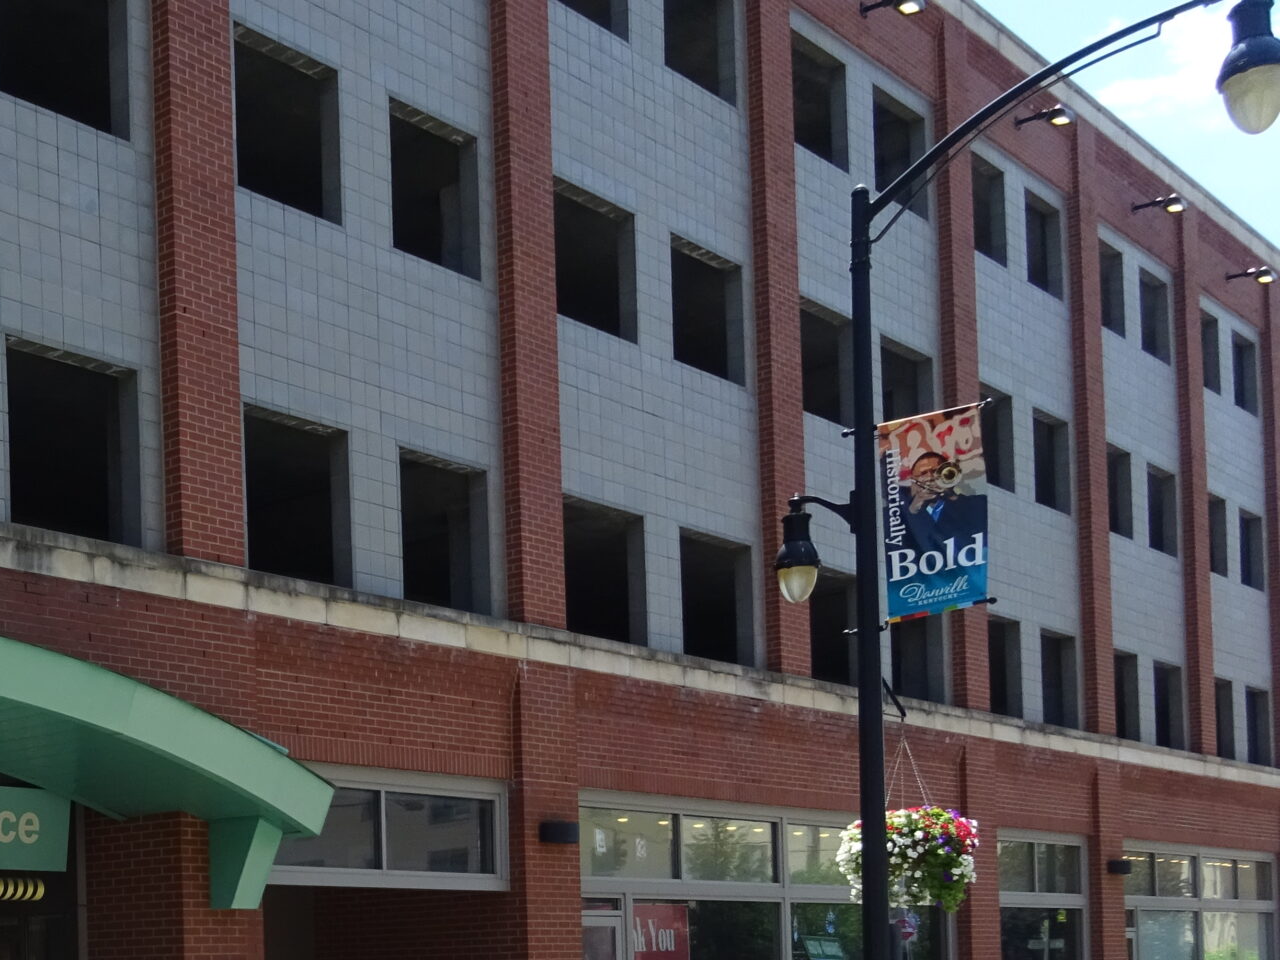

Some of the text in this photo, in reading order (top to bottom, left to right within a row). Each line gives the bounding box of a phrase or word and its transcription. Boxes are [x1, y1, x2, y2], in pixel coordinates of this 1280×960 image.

[885, 449, 907, 546] Historically
[888, 532, 987, 582] Bold
[899, 575, 970, 602] Danville
[647, 918, 675, 952] You
